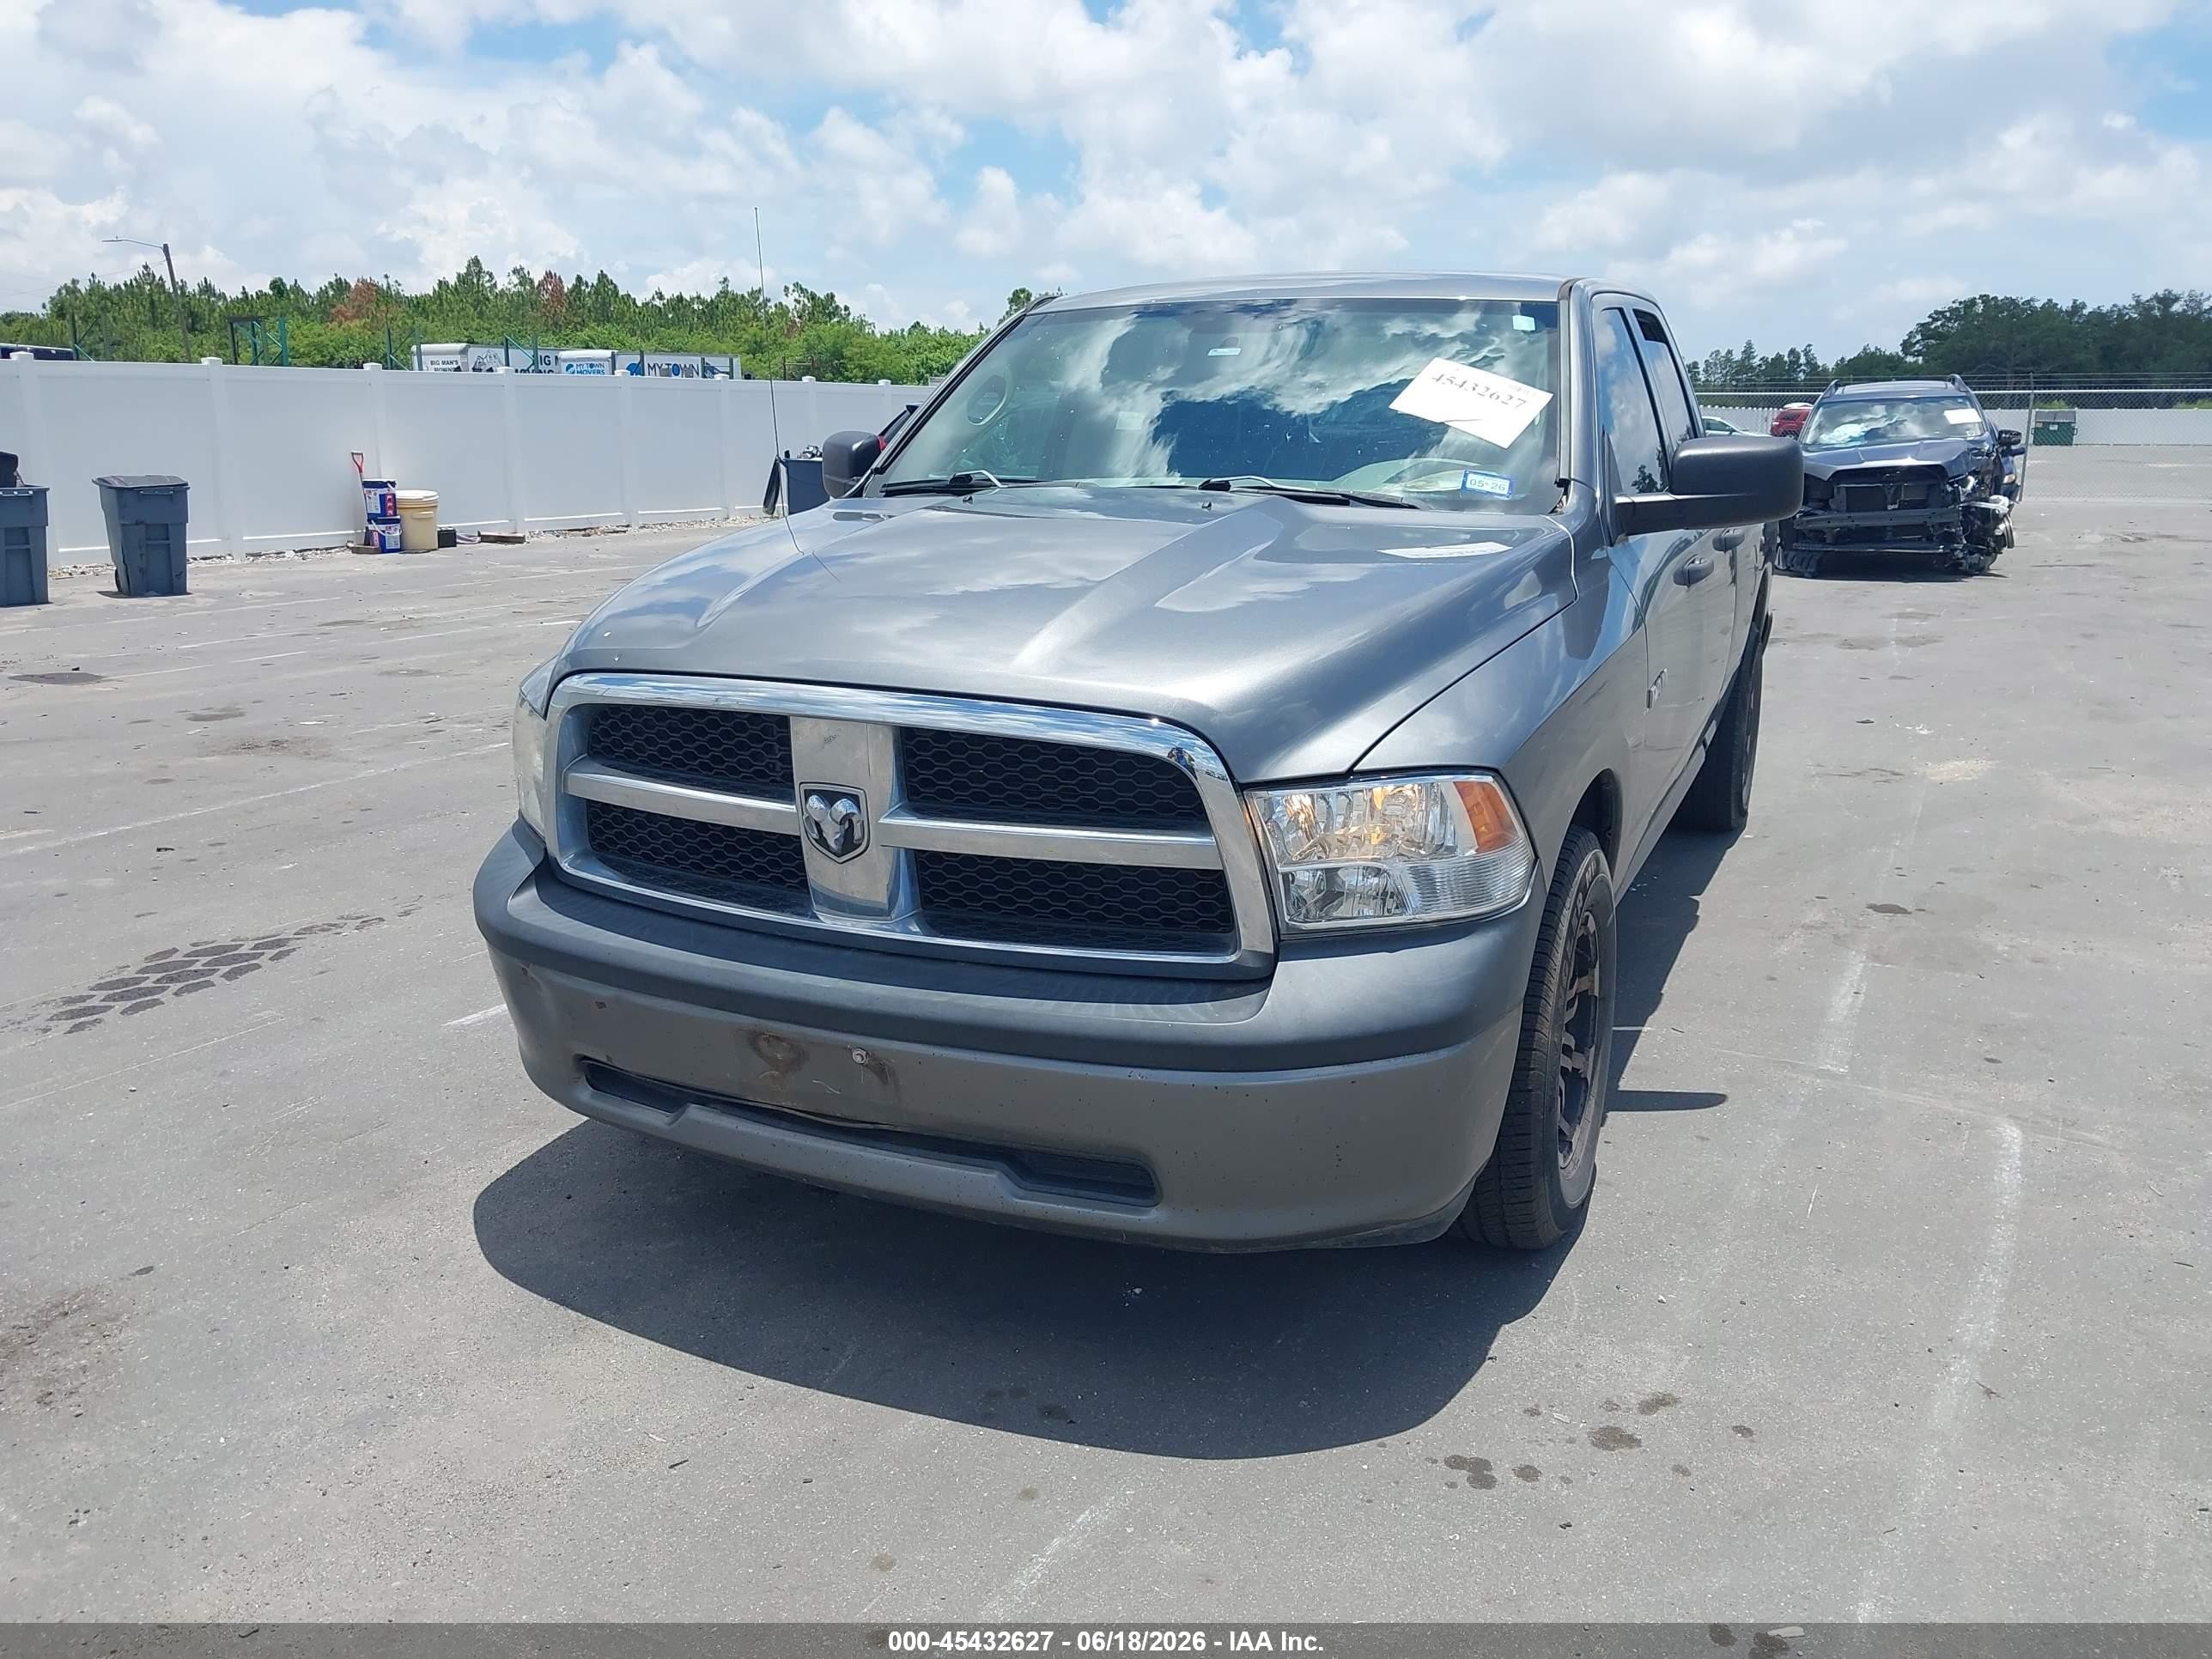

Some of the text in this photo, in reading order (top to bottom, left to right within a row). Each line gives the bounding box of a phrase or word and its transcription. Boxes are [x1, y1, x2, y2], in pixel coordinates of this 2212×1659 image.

[647, 362, 663, 376] MY
[665, 362, 700, 378] TOWN
[1431, 374, 1528, 409] 45432627
[1469, 478, 1485, 488] 05
[1490, 482, 1505, 491] 26
